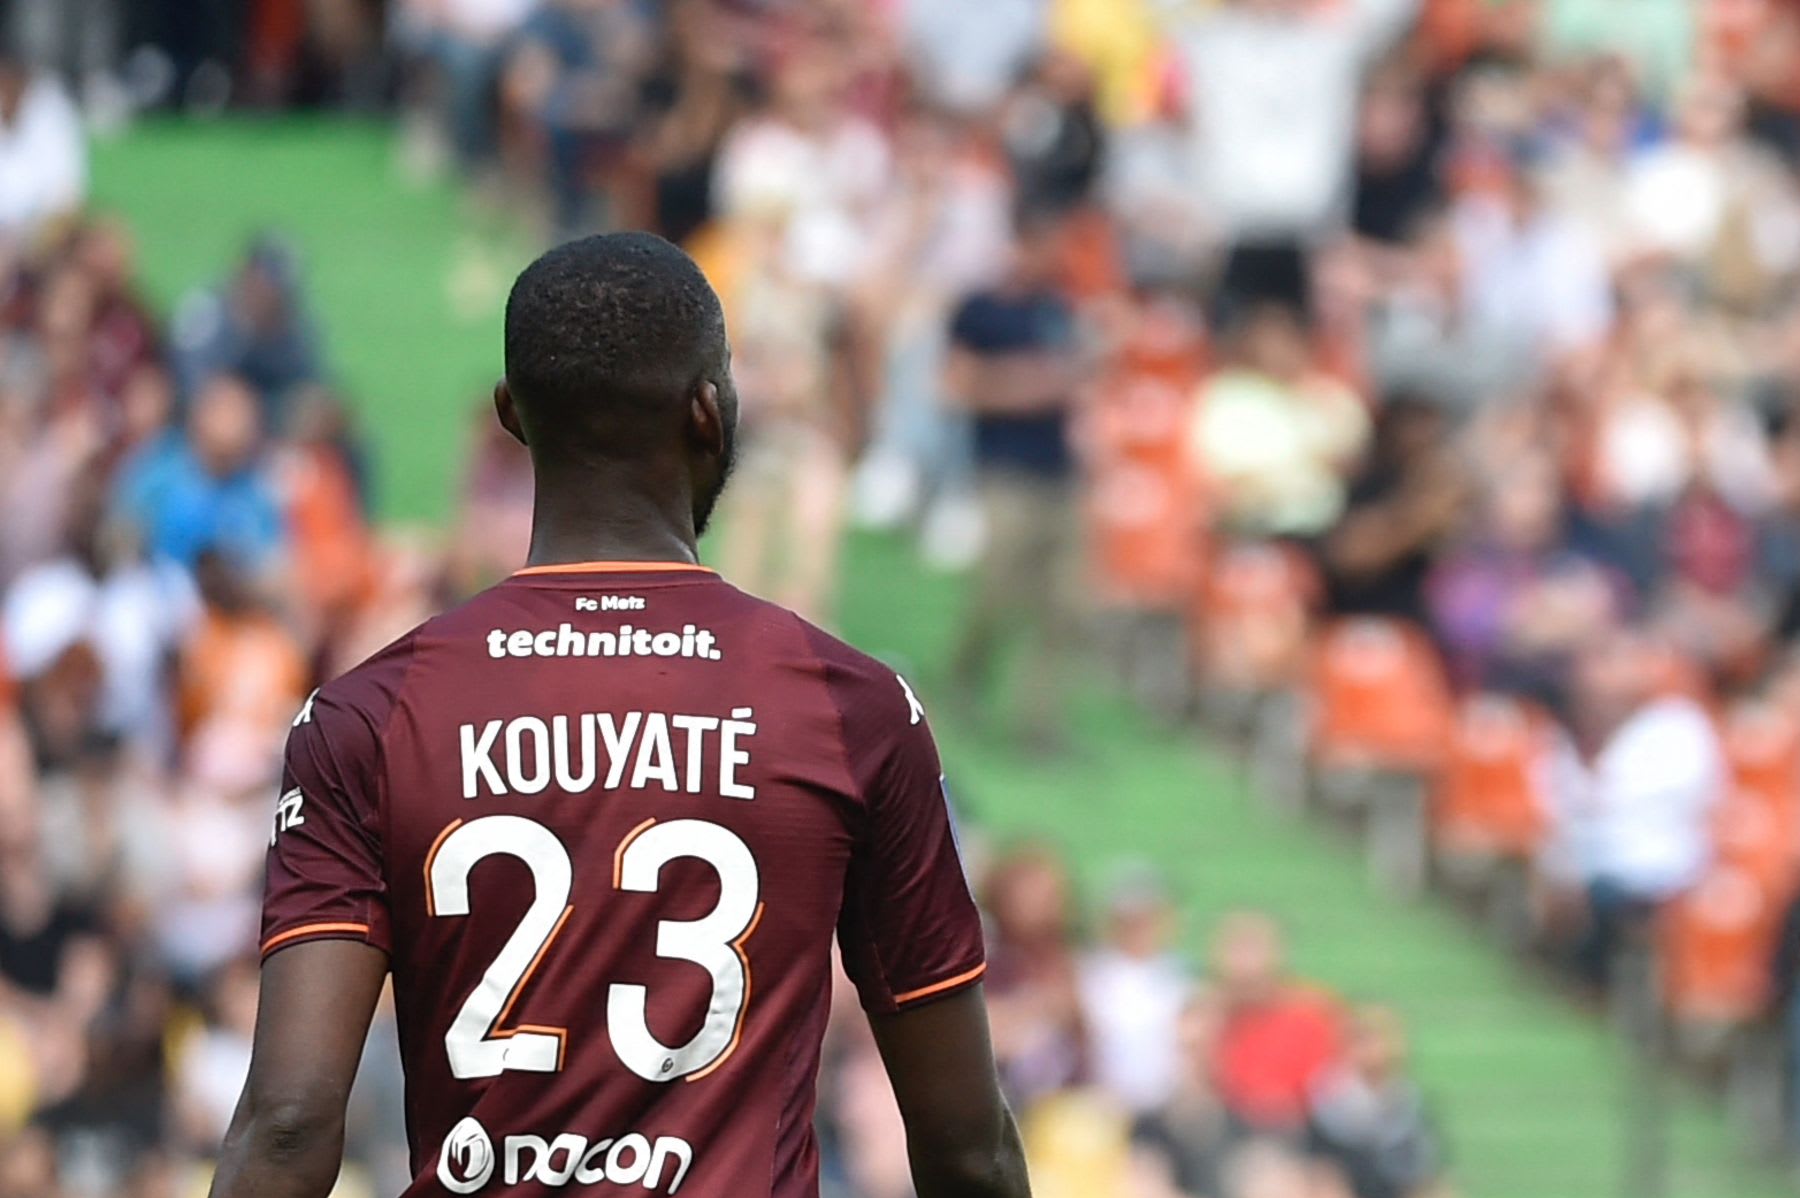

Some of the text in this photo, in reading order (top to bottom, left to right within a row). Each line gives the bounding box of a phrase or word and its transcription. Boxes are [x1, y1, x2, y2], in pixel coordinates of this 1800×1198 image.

[575, 595, 646, 611] Fc Metz
[486, 623, 722, 660] technitoit.
[458, 707, 757, 799] KOUYATÉ
[424, 814, 764, 1083] 23
[504, 1132, 693, 1196] nacon
